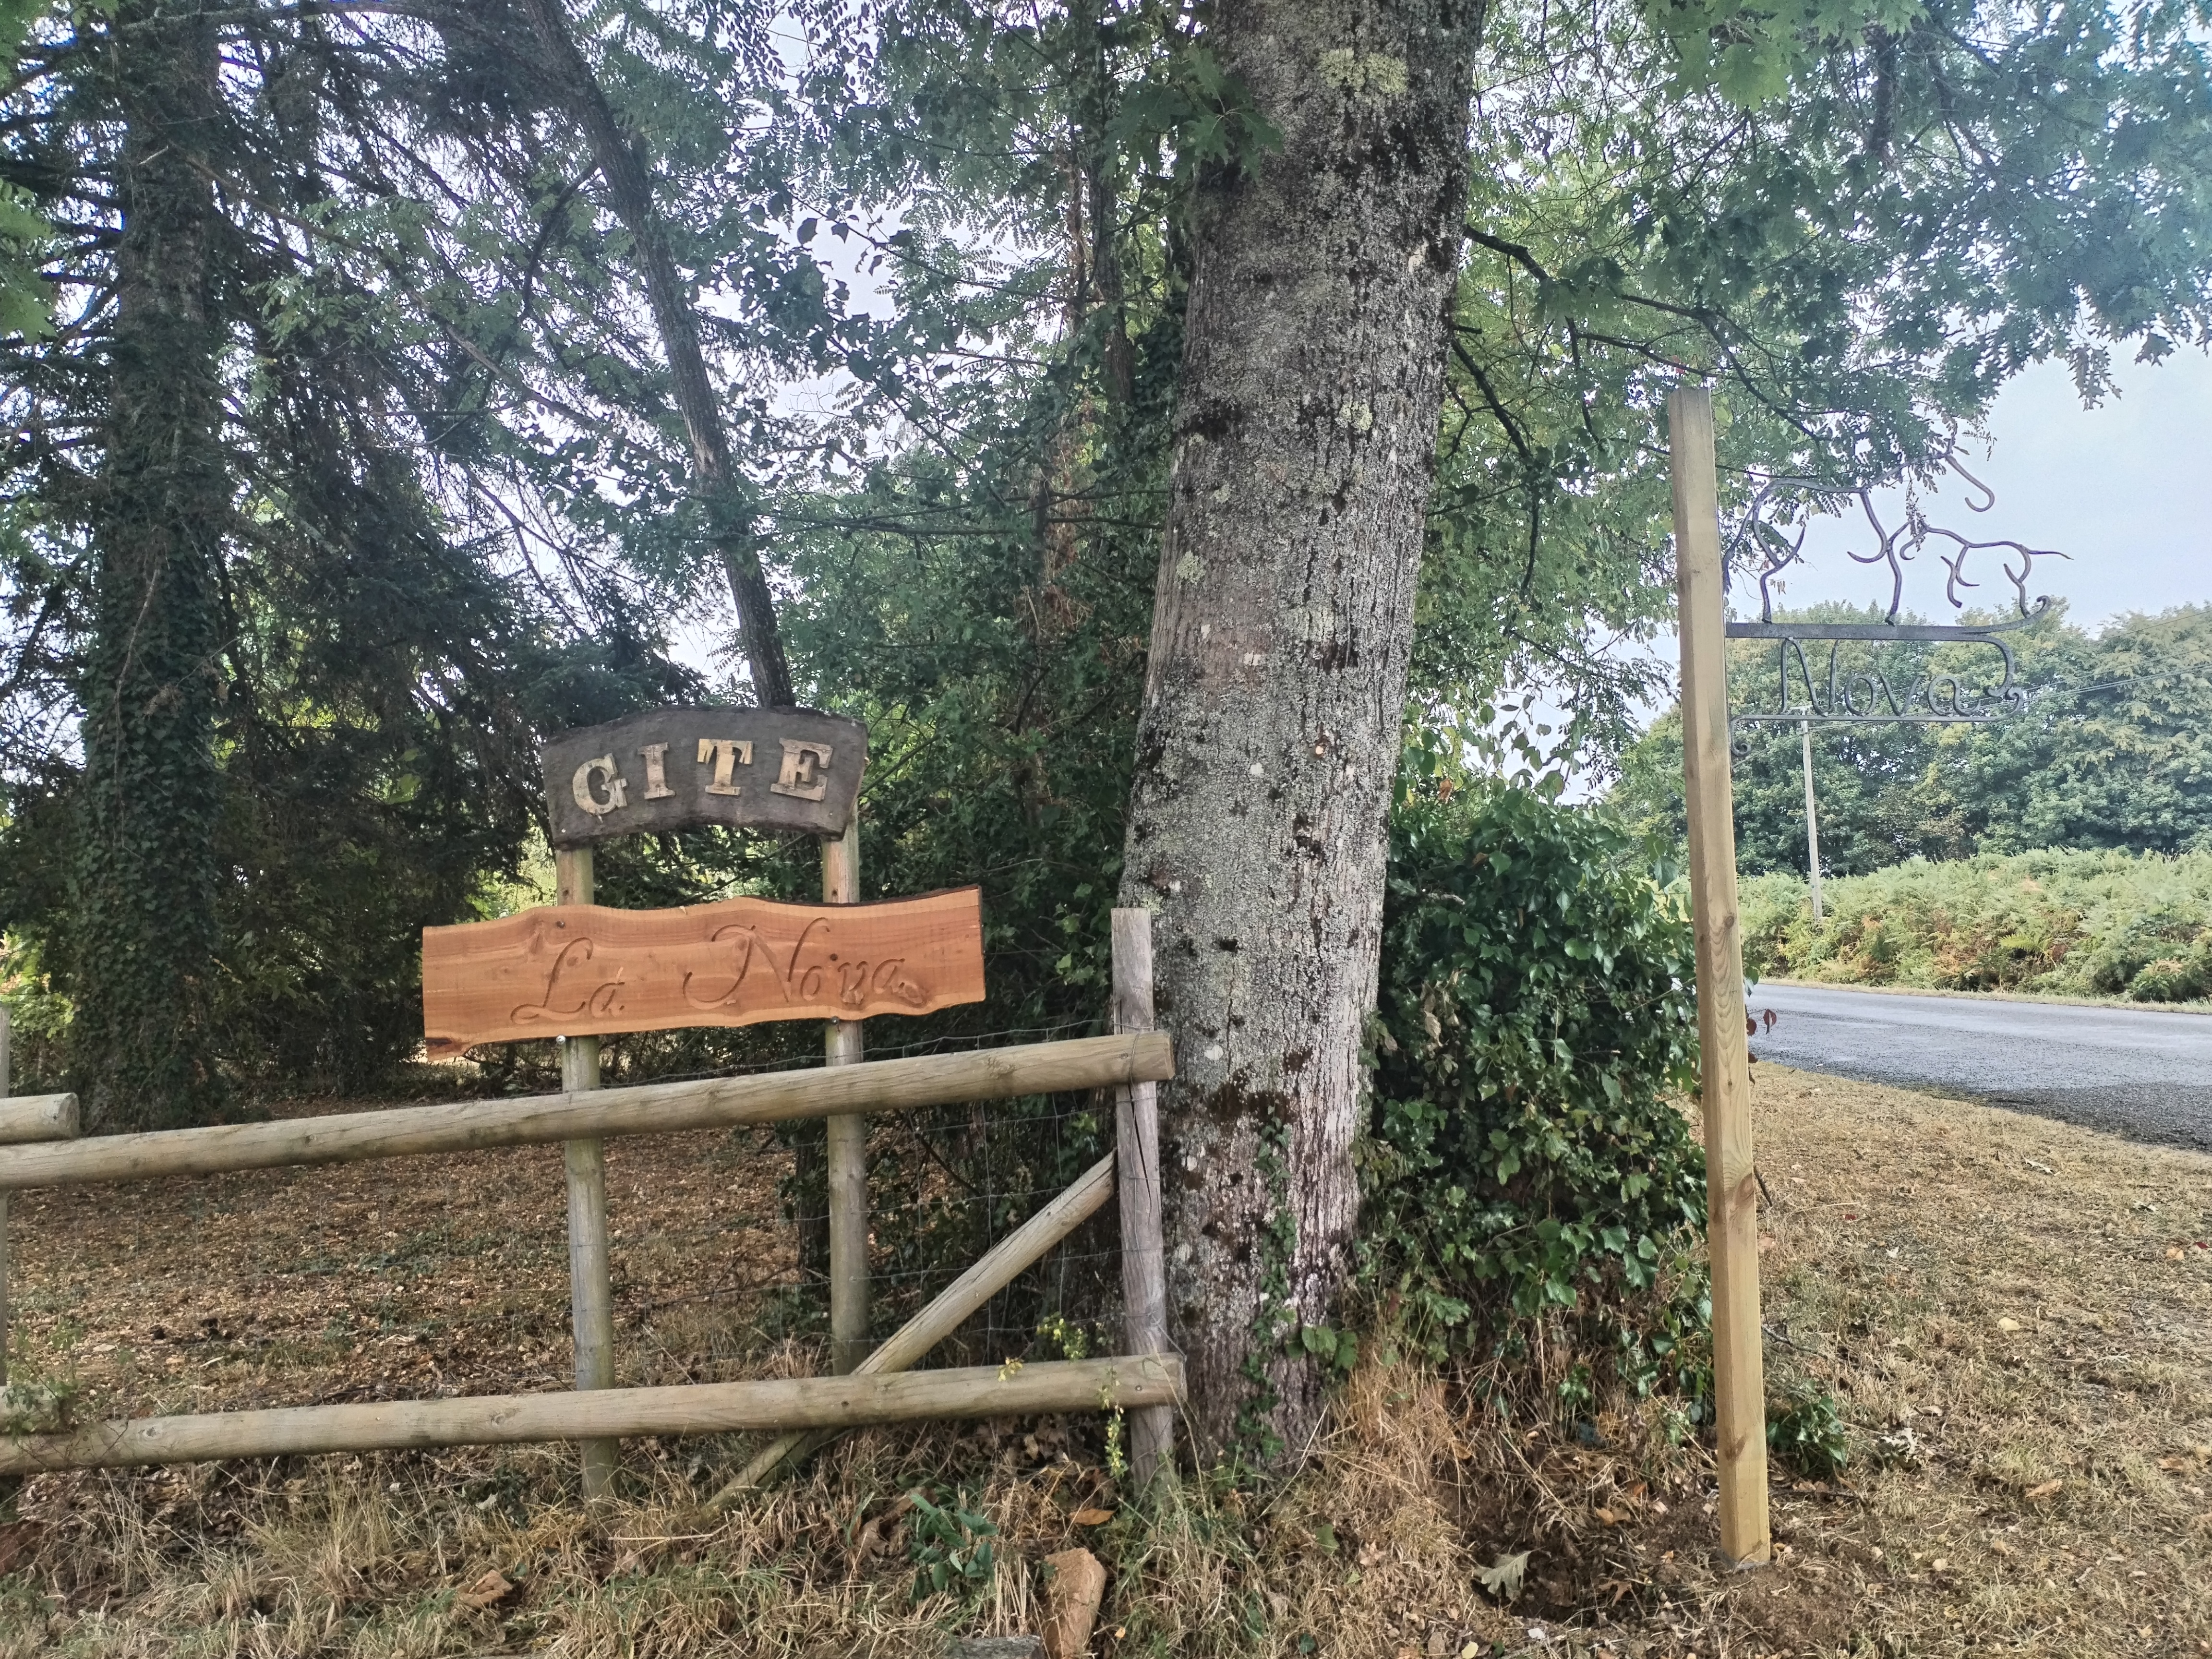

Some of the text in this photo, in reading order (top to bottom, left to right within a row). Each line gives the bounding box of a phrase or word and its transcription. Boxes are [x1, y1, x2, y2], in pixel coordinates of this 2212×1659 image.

[1780, 637, 1981, 717] Nova
[573, 738, 833, 815] GITE
[510, 917, 905, 1024] La Nova
